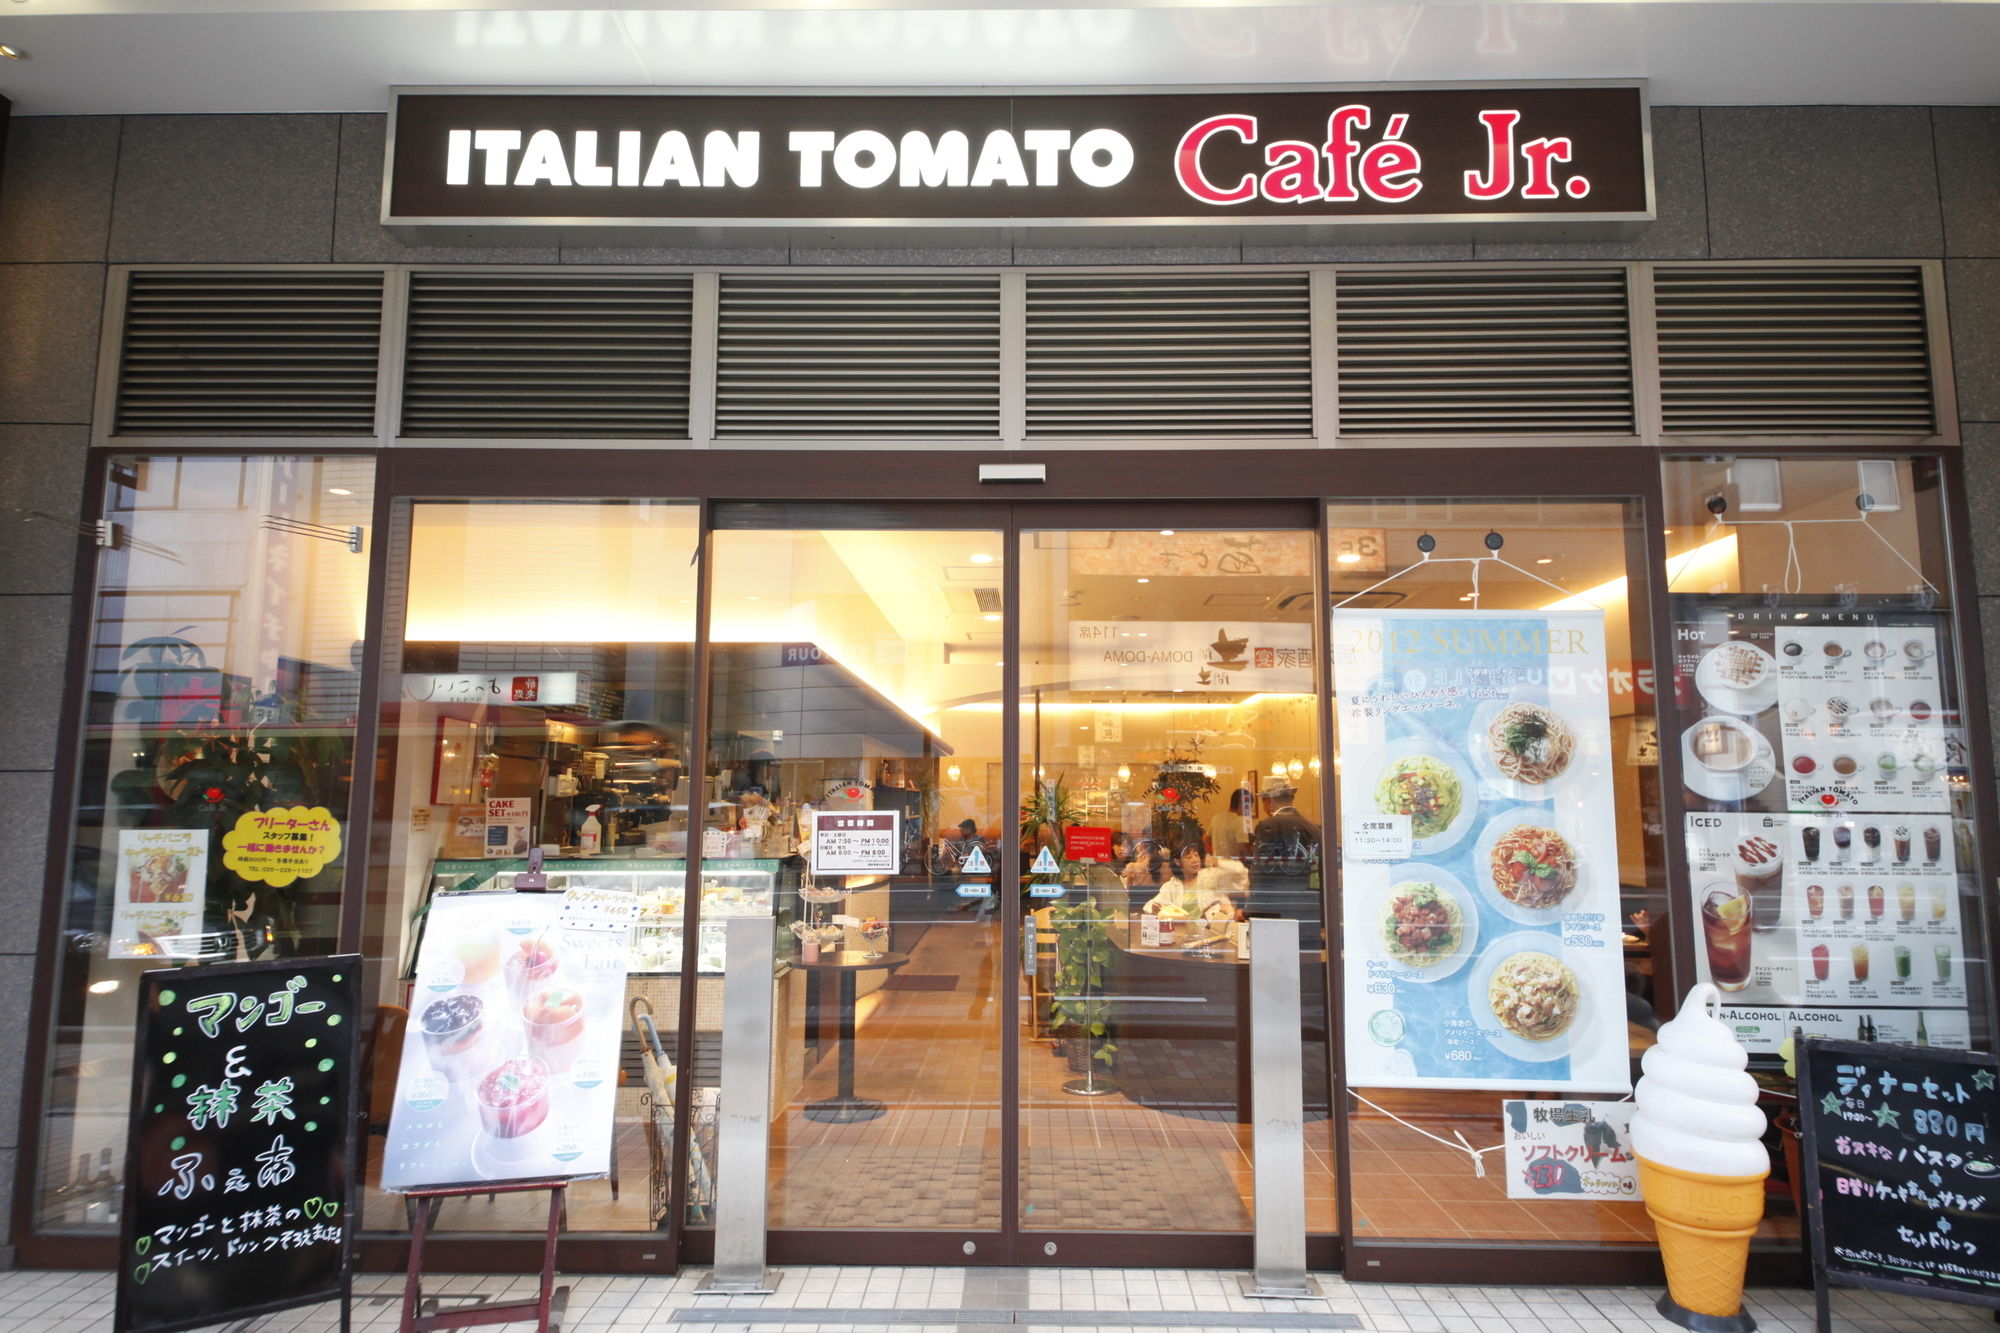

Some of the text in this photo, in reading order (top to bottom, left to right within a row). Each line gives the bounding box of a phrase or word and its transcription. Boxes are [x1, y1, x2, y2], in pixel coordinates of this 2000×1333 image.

[446, 104, 1591, 206] ITALIAN TOMATO Café Jr.
[1738, 613, 1875, 621] DRIN MENU
[1350, 629, 1589, 655] 2012 SUMMER
[1799, 786, 1826, 805] ITALIAN
[1828, 785, 1858, 805] TOMATO
[489, 800, 515, 808] CAKE
[488, 809, 505, 817] SET
[1690, 815, 1722, 828] ICED
[254, 817, 330, 831] フリーターさん
[1362, 822, 1393, 830] 全席禁煙
[560, 933, 623, 951] Sweets
[583, 953, 617, 970] Fair
[1367, 982, 1395, 994] ¥630
[187, 975, 326, 1039] マンゴー
[1706, 1010, 1781, 1021] NN-ALCOHOL
[1788, 1011, 1843, 1022] ALCOHOL
[1444, 1050, 1472, 1061] ¥680
[1836, 1064, 1971, 1104] ディナーセット
[187, 1077, 296, 1130] 抹茶
[1845, 1097, 1866, 1109] 毎日
[1533, 1107, 1596, 1123] 牧場生乳
[1913, 1108, 1985, 1144] 880円
[1514, 1131, 1545, 1141] おいしい
[1521, 1145, 1628, 1163] ソフトクリーム
[1898, 1144, 1963, 1169] パスタ
[158, 1134, 296, 1200] ふぇあ
[154, 1204, 301, 1246] マンゴーと抹茶の
[1897, 1225, 1977, 1255] セットドリンク
